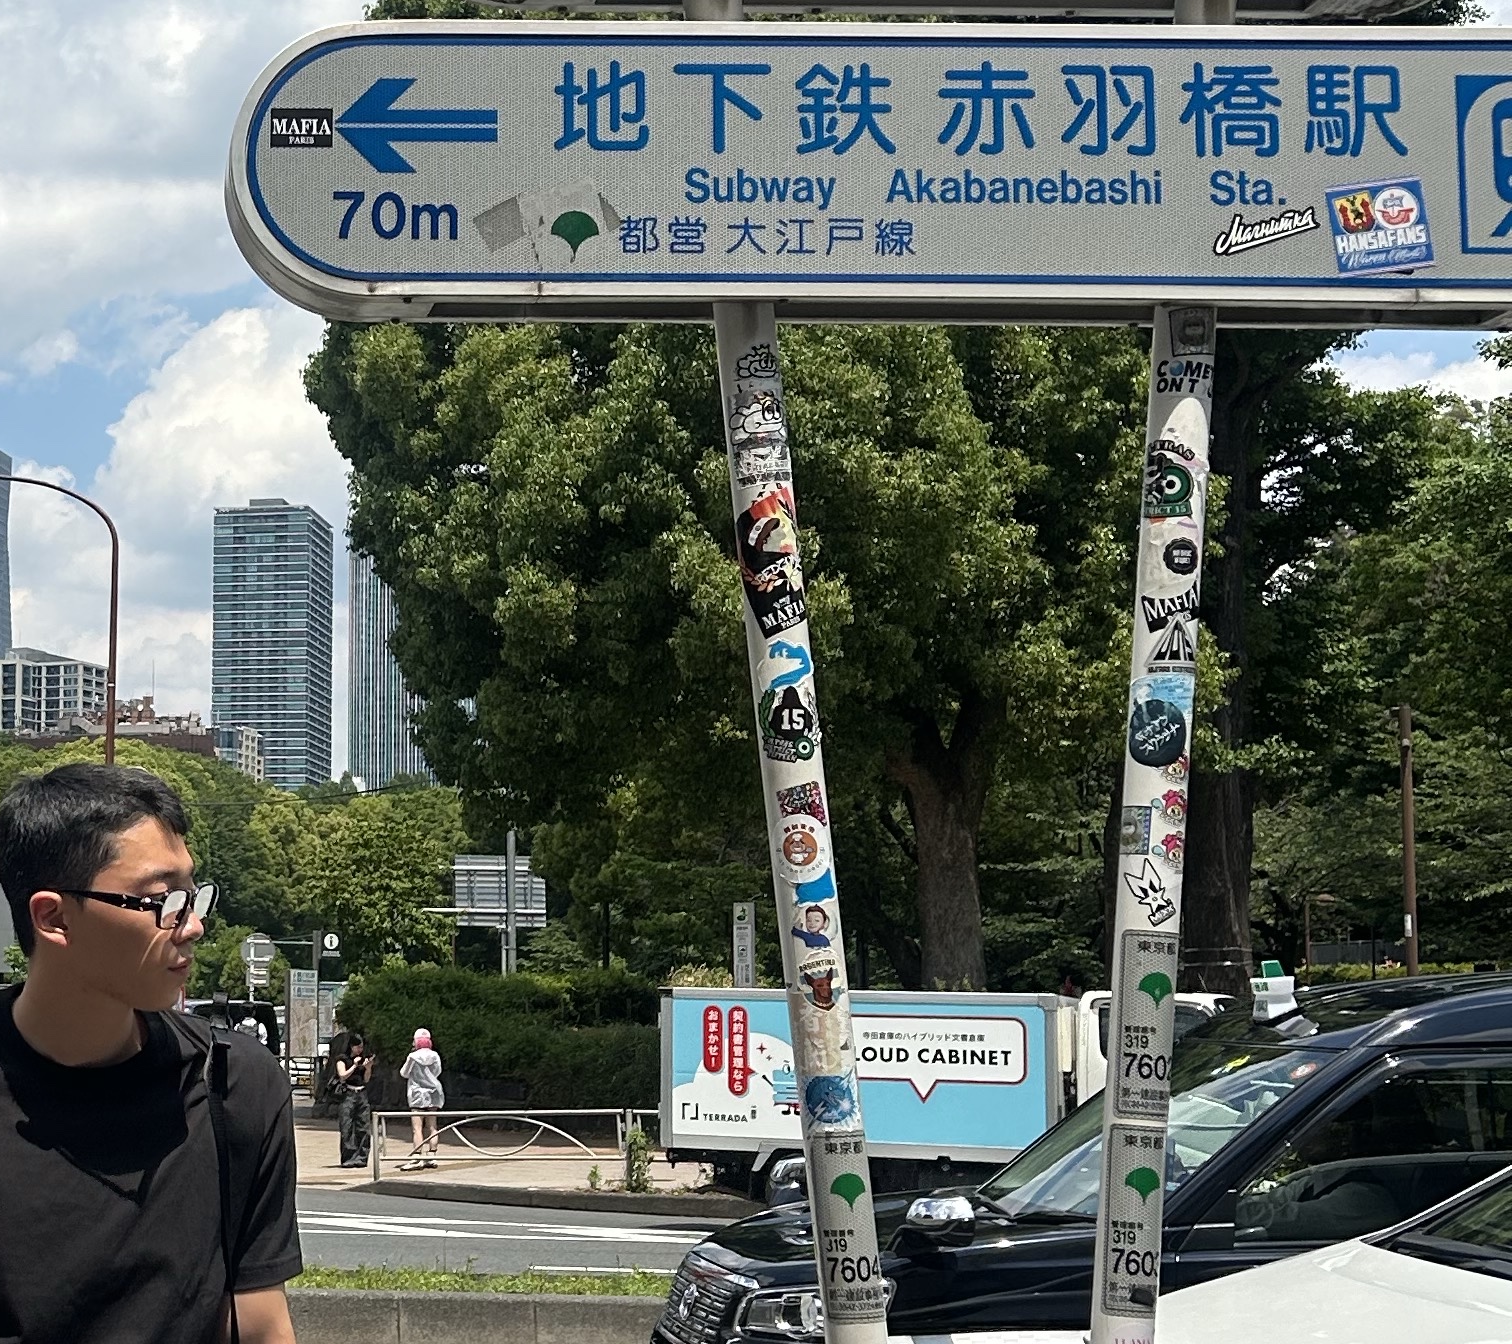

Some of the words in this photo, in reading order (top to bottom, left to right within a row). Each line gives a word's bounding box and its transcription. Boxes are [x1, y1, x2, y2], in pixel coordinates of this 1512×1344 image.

[271, 117, 333, 136] MAFIA
[685, 167, 838, 211] Subway
[885, 166, 1164, 207] Akabanebashi
[1209, 169, 1287, 207] Sta.
[332, 190, 459, 242] 70m
[1335, 225, 1427, 254] HANSAFANS
[762, 599, 806, 630] MAFIA
[1143, 587, 1200, 622] MAFIA
[781, 708, 805, 731] 15
[1124, 1035, 1150, 1049] 319
[917, 1048, 1012, 1066] CABINET
[703, 1113, 748, 1123] TERRADA
[1112, 1231, 1137, 1245] 319
[826, 1256, 882, 1283] 7604
